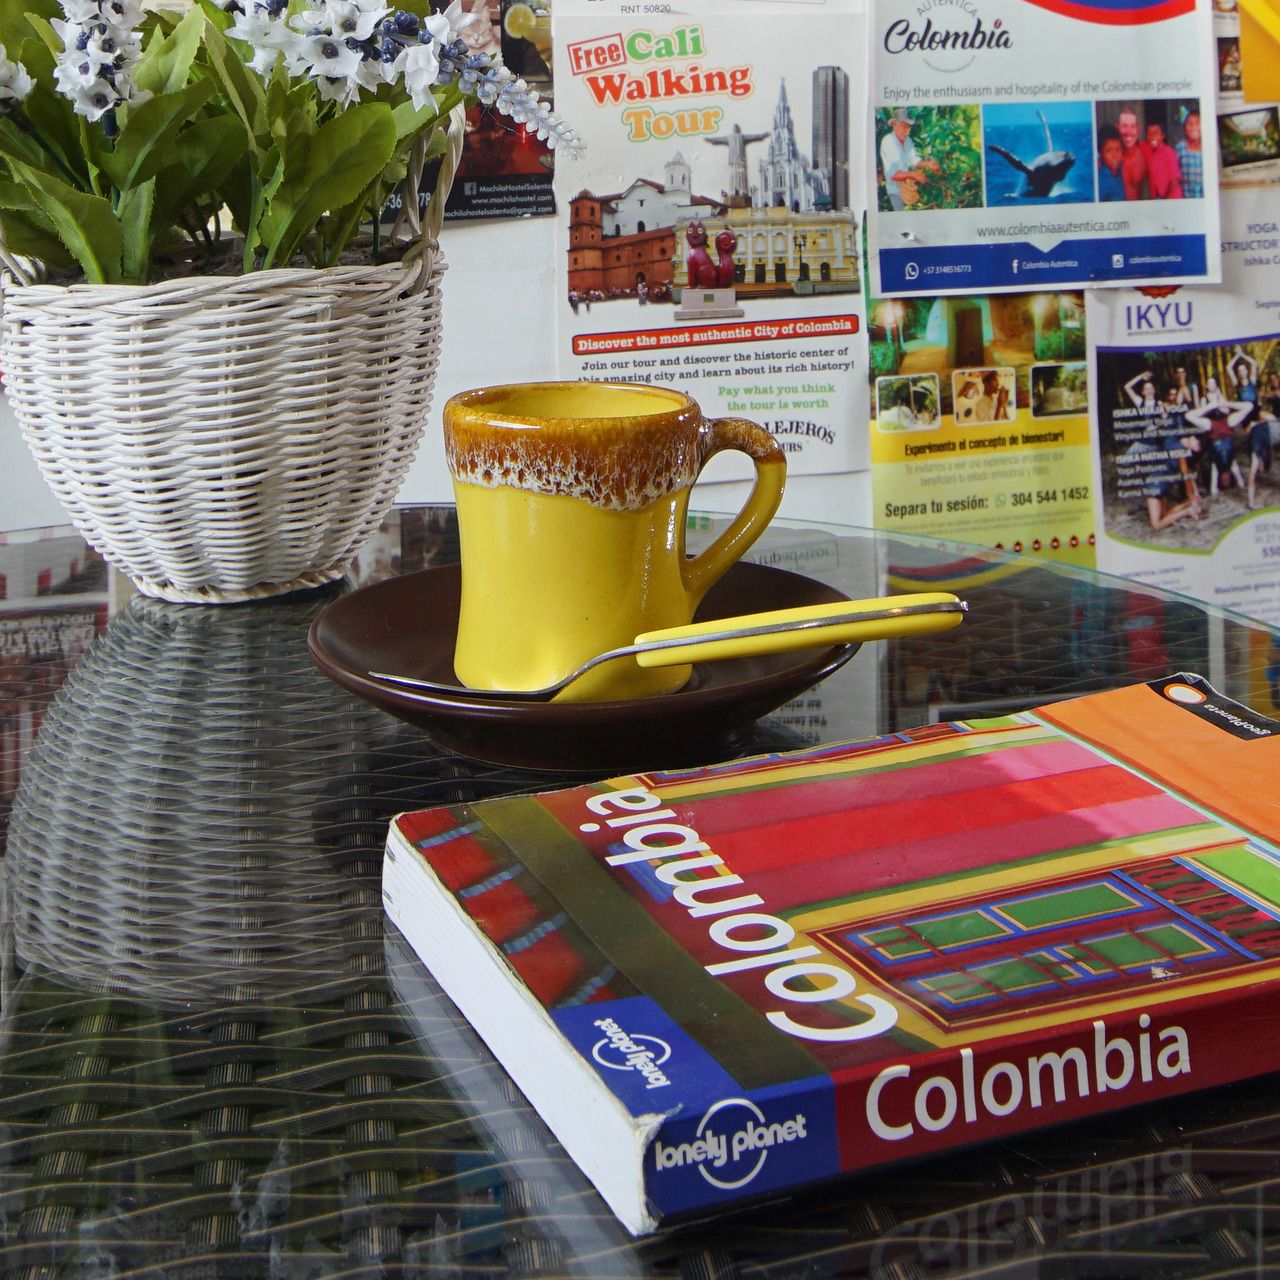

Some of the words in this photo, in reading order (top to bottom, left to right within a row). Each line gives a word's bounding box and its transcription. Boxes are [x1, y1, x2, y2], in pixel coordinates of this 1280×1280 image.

[621, 5, 641, 14] RNT
[644, 4, 671, 14] 50820
[572, 43, 621, 70] Free
[626, 27, 704, 61] Cali
[884, 19, 1014, 54] Colombia
[586, 65, 752, 104] Walking
[883, 86, 911, 100] Enjoy
[914, 86, 932, 97] the
[933, 83, 992, 97] enthusiasm
[994, 83, 1014, 95] and
[1016, 80, 1068, 97] hospitality
[1070, 80, 1081, 93] of
[1084, 80, 1100, 92] the
[1102, 79, 1155, 92] Colombian
[1157, 78, 1193, 93] people
[624, 108, 722, 139] Tour
[977, 220, 1130, 238] www.colombiaautentica.com
[1125, 300, 1194, 331] IKYU
[577, 337, 634, 352] Discover
[636, 334, 657, 346] the
[660, 332, 691, 345] most
[693, 327, 752, 343] authentic
[753, 324, 780, 339] City
[782, 323, 795, 334] of
[795, 319, 852, 334] Colombia
[582, 360, 607, 372] Join
[610, 359, 630, 370] our
[633, 357, 657, 368] tour
[660, 356, 681, 366] and
[684, 353, 731, 365] discover
[733, 351, 752, 362] the
[754, 348, 798, 361] historic
[800, 349, 835, 359] center
[837, 346, 850, 357] of
[885, 501, 928, 519] Separa
[931, 499, 943, 513] tu
[947, 496, 989, 512] sesión:
[1012, 492, 1032, 507] 304
[1037, 490, 1057, 504] 544
[1062, 486, 1089, 501] 1452
[1204, 704, 1271, 735] geoPlaneta
[579, 784, 899, 1043] Colombia
[593, 1018, 646, 1053] planet
[626, 1051, 672, 1089] lonely
[864, 1011, 1193, 1142] Colombia
[655, 1129, 727, 1171] lonely
[732, 1114, 808, 1162] planet
